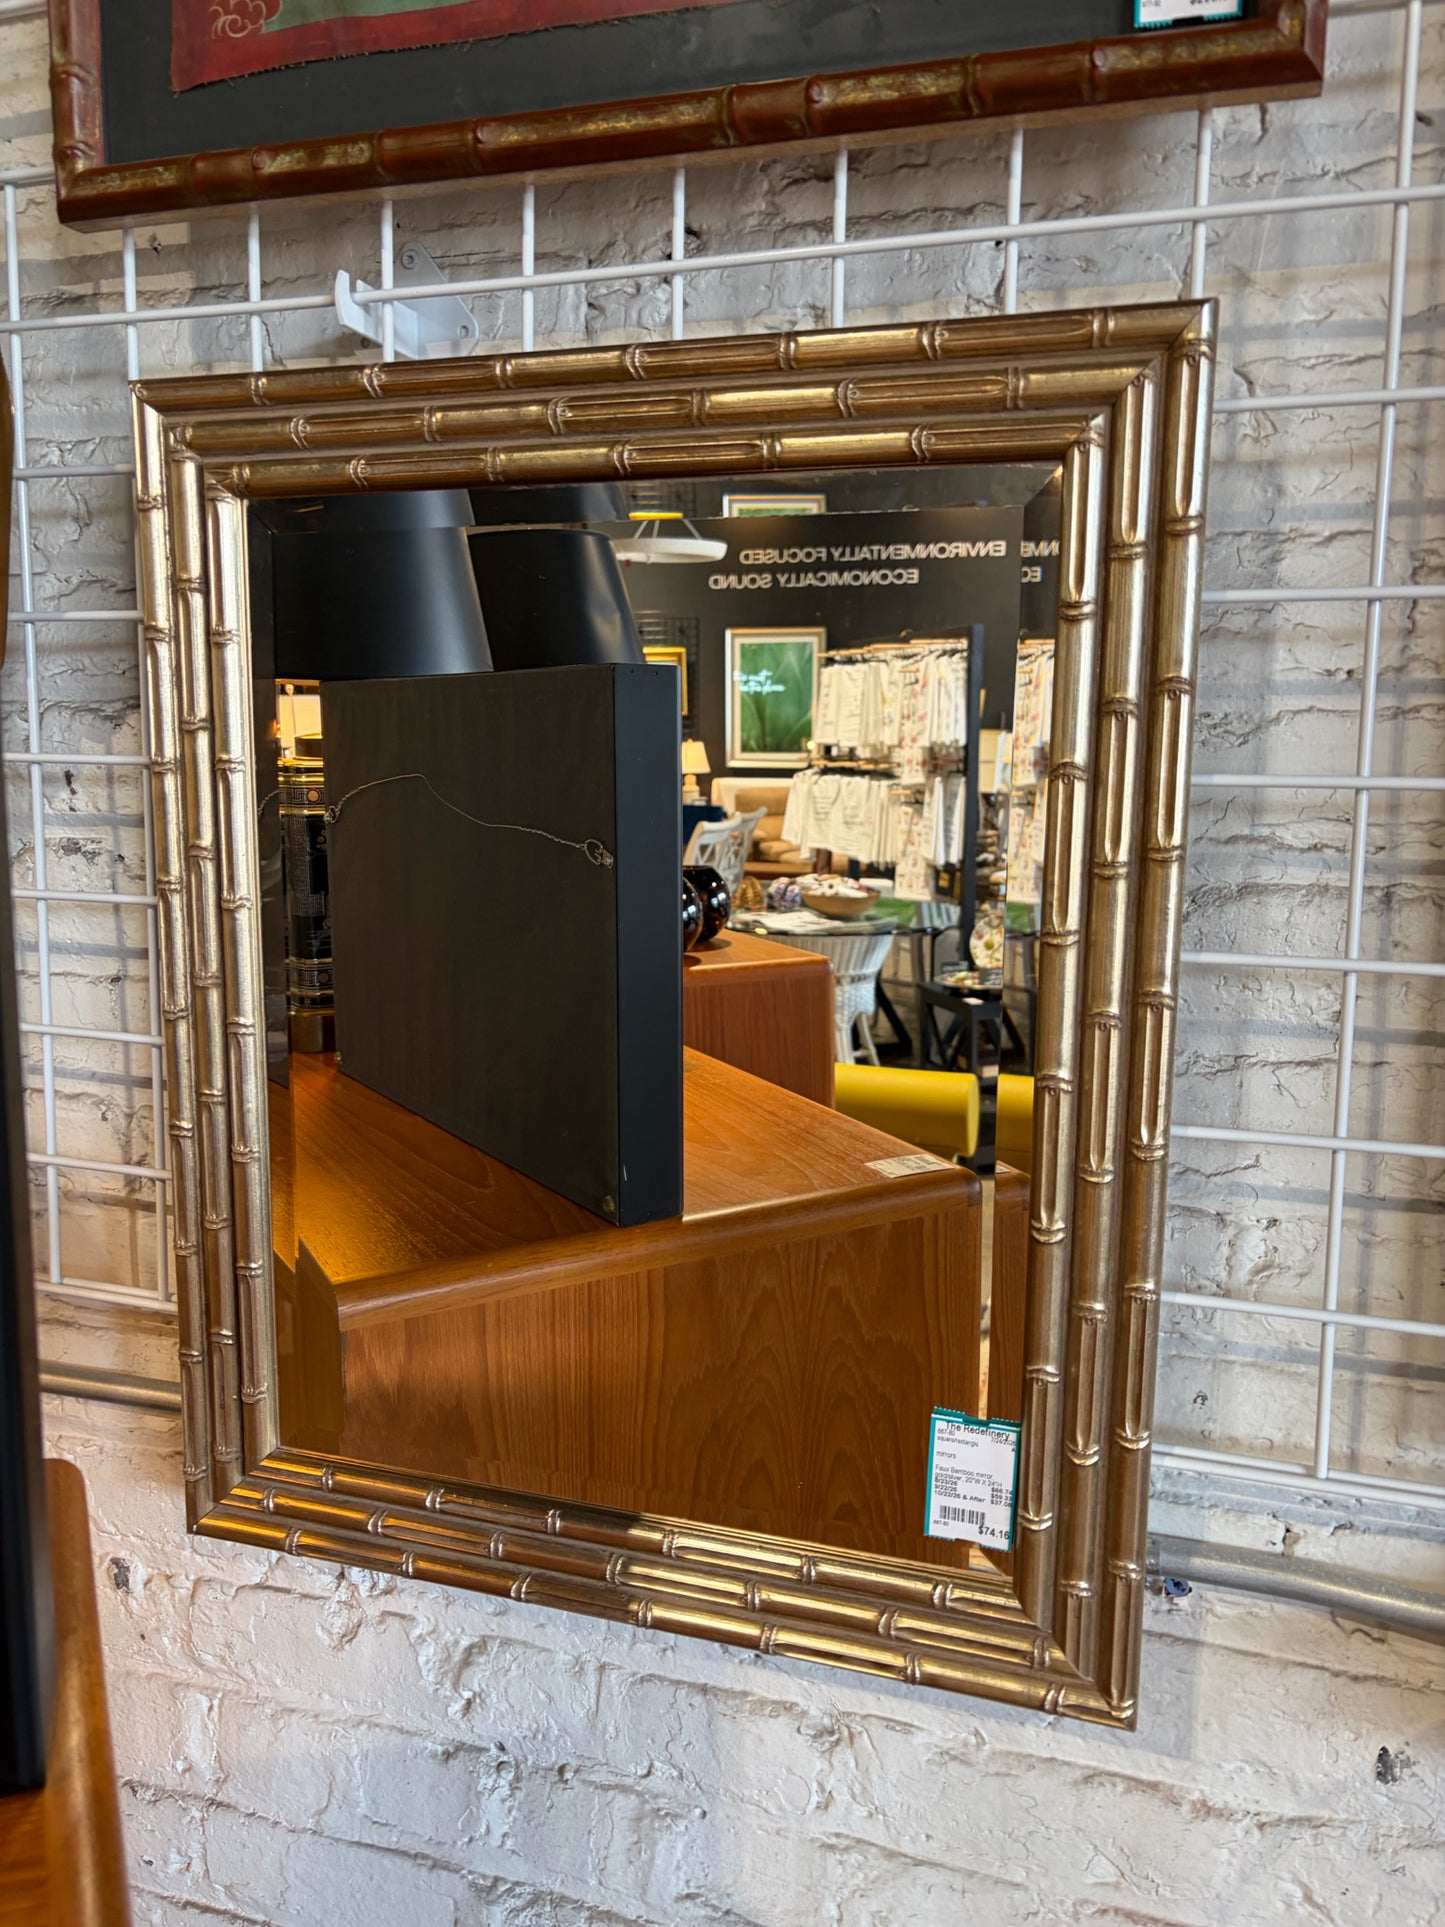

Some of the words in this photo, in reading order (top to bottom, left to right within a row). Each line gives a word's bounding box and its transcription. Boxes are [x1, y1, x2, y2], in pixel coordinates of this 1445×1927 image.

[946, 1422, 961, 1431] The
[963, 1424, 1010, 1441] Redefinery
[936, 1450, 956, 1459] mirrors
[935, 1464, 949, 1472] Faux
[951, 1467, 974, 1477] Bamboo
[969, 1495, 986, 1503] After
[978, 1525, 1010, 1540] $74.16
